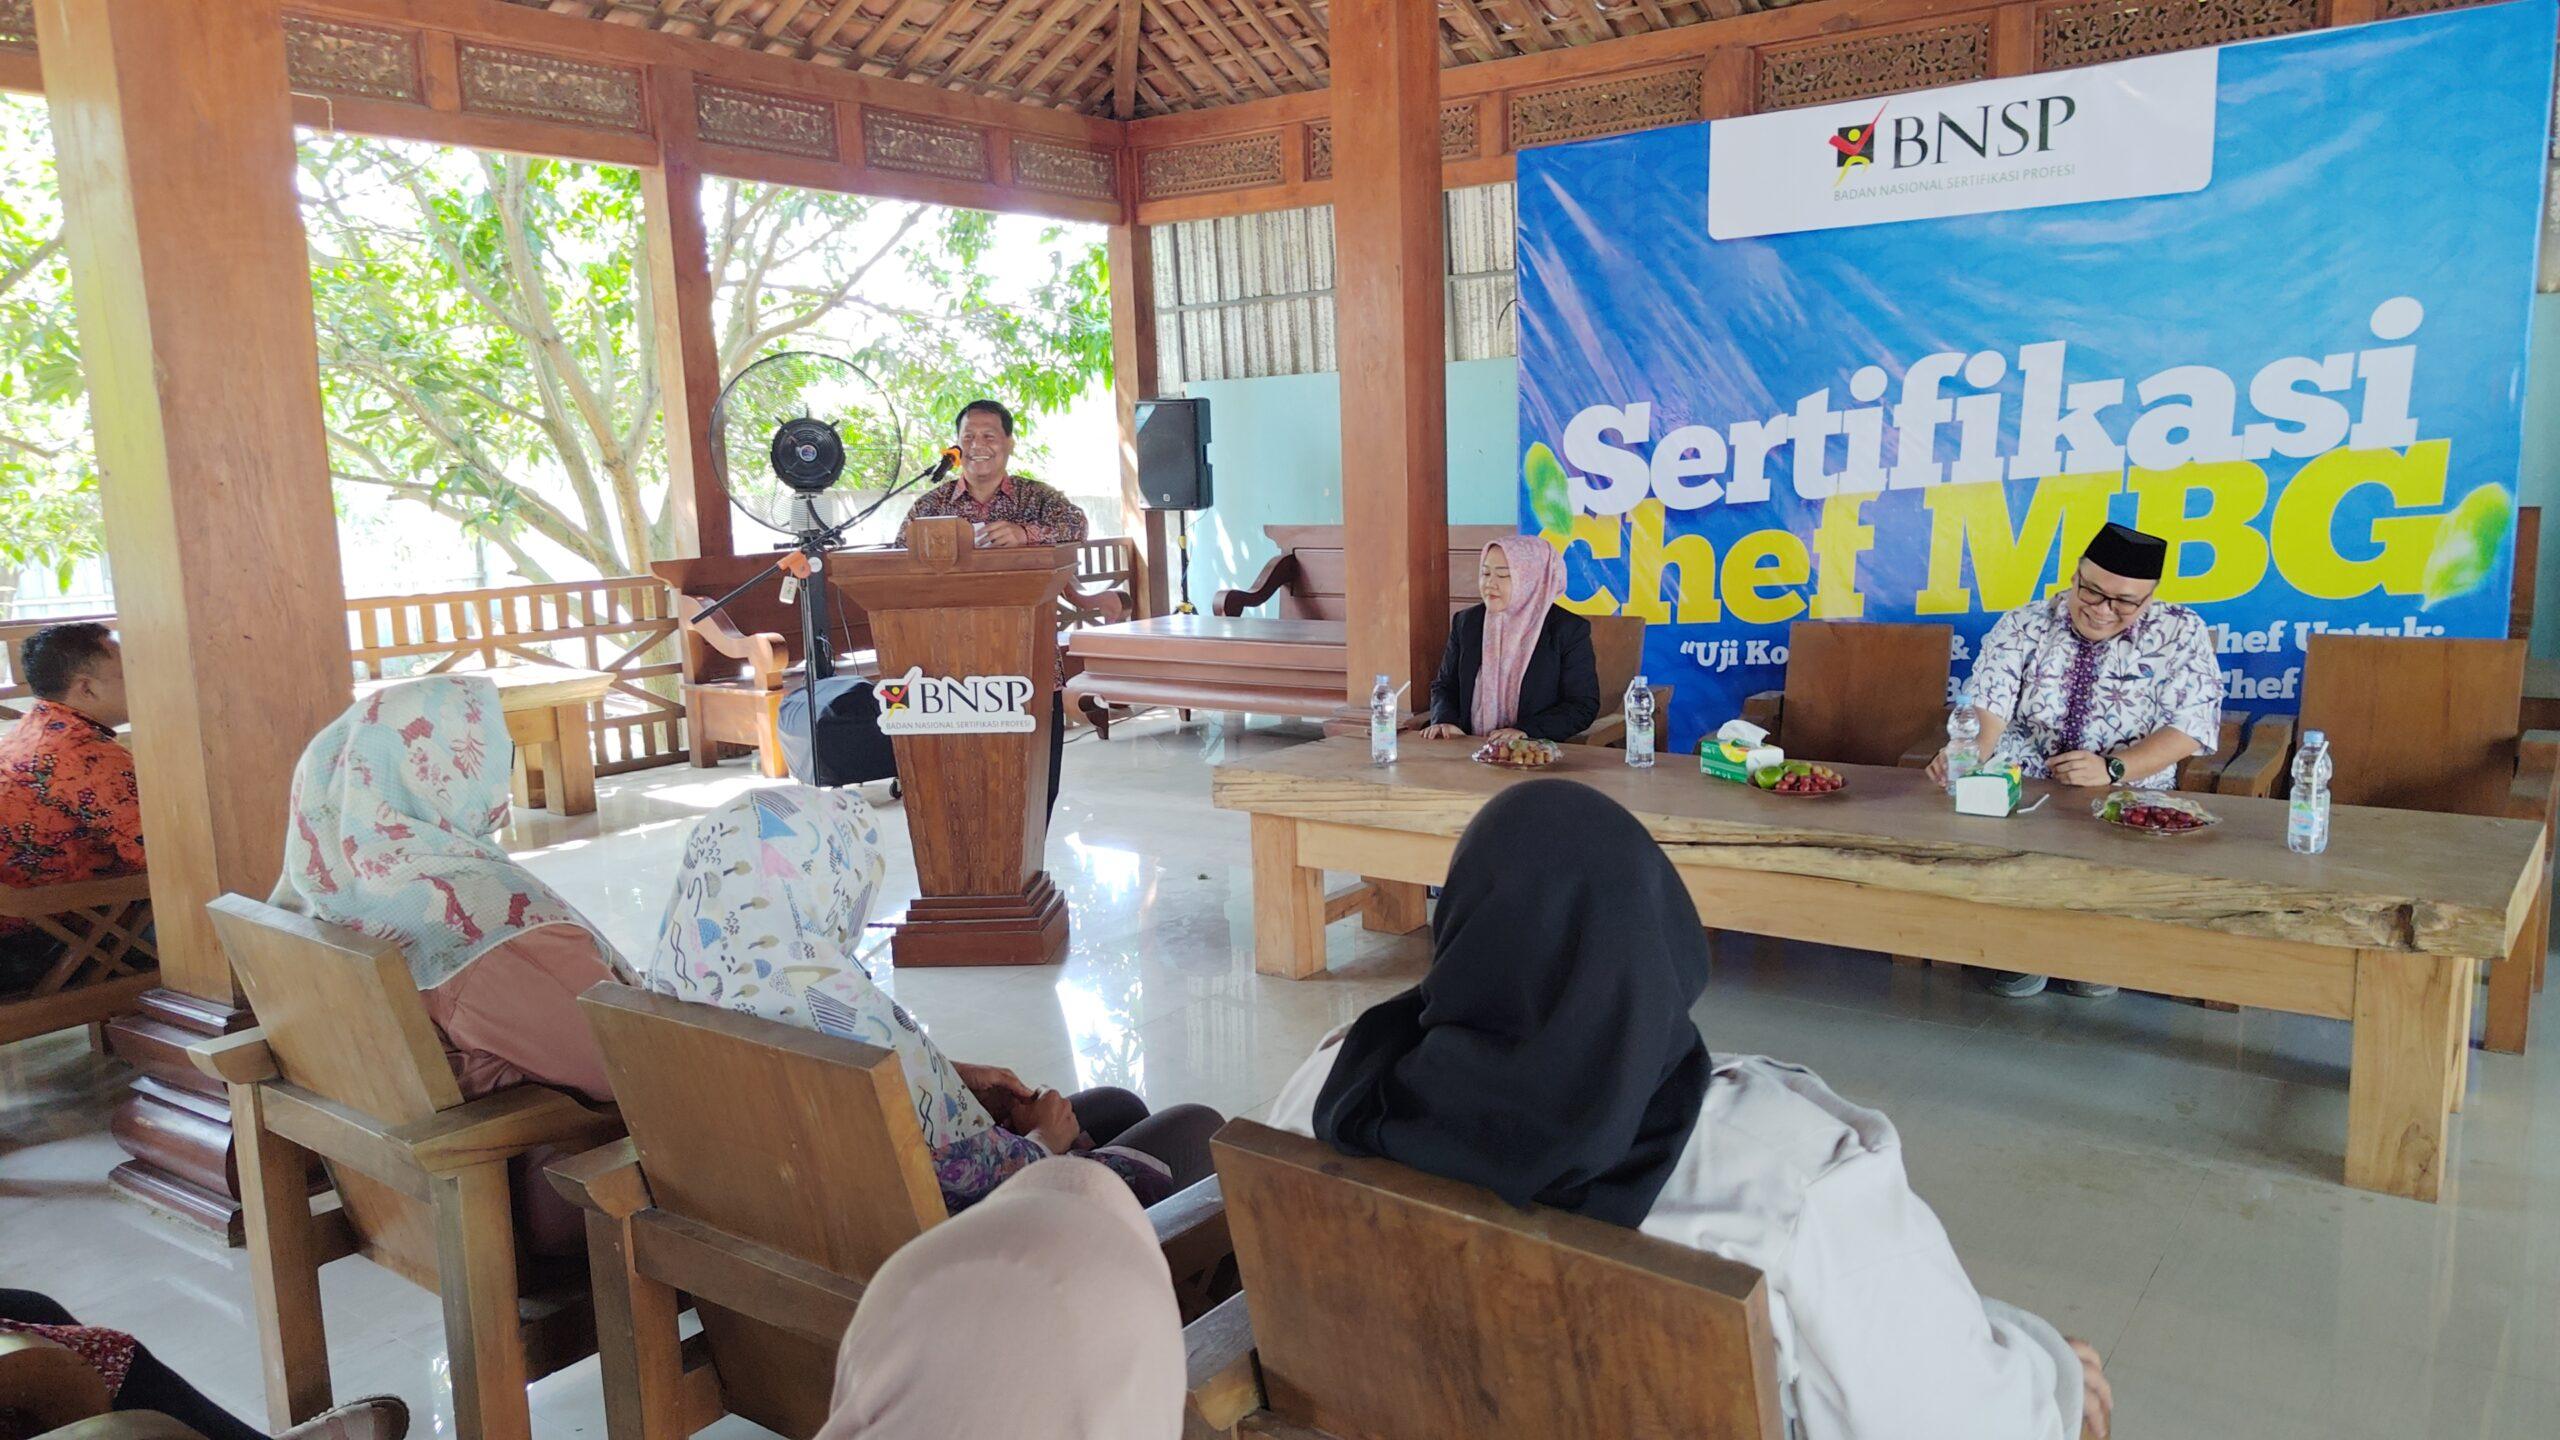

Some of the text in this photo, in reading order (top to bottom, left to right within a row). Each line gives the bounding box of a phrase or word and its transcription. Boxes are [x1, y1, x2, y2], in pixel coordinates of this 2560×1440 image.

[1891, 95, 2076, 169] BNSP
[1833, 163, 2077, 202] BADAN NASIONAL SERTIFIKASI PROFESI
[1563, 296, 2424, 517] Sertifikasi
[1538, 438, 2451, 625] Chef MBG
[886, 719, 1031, 730] BADAN NASIONAL SERTIFIKASI PROFESI
[920, 681, 1028, 714] BNSP
